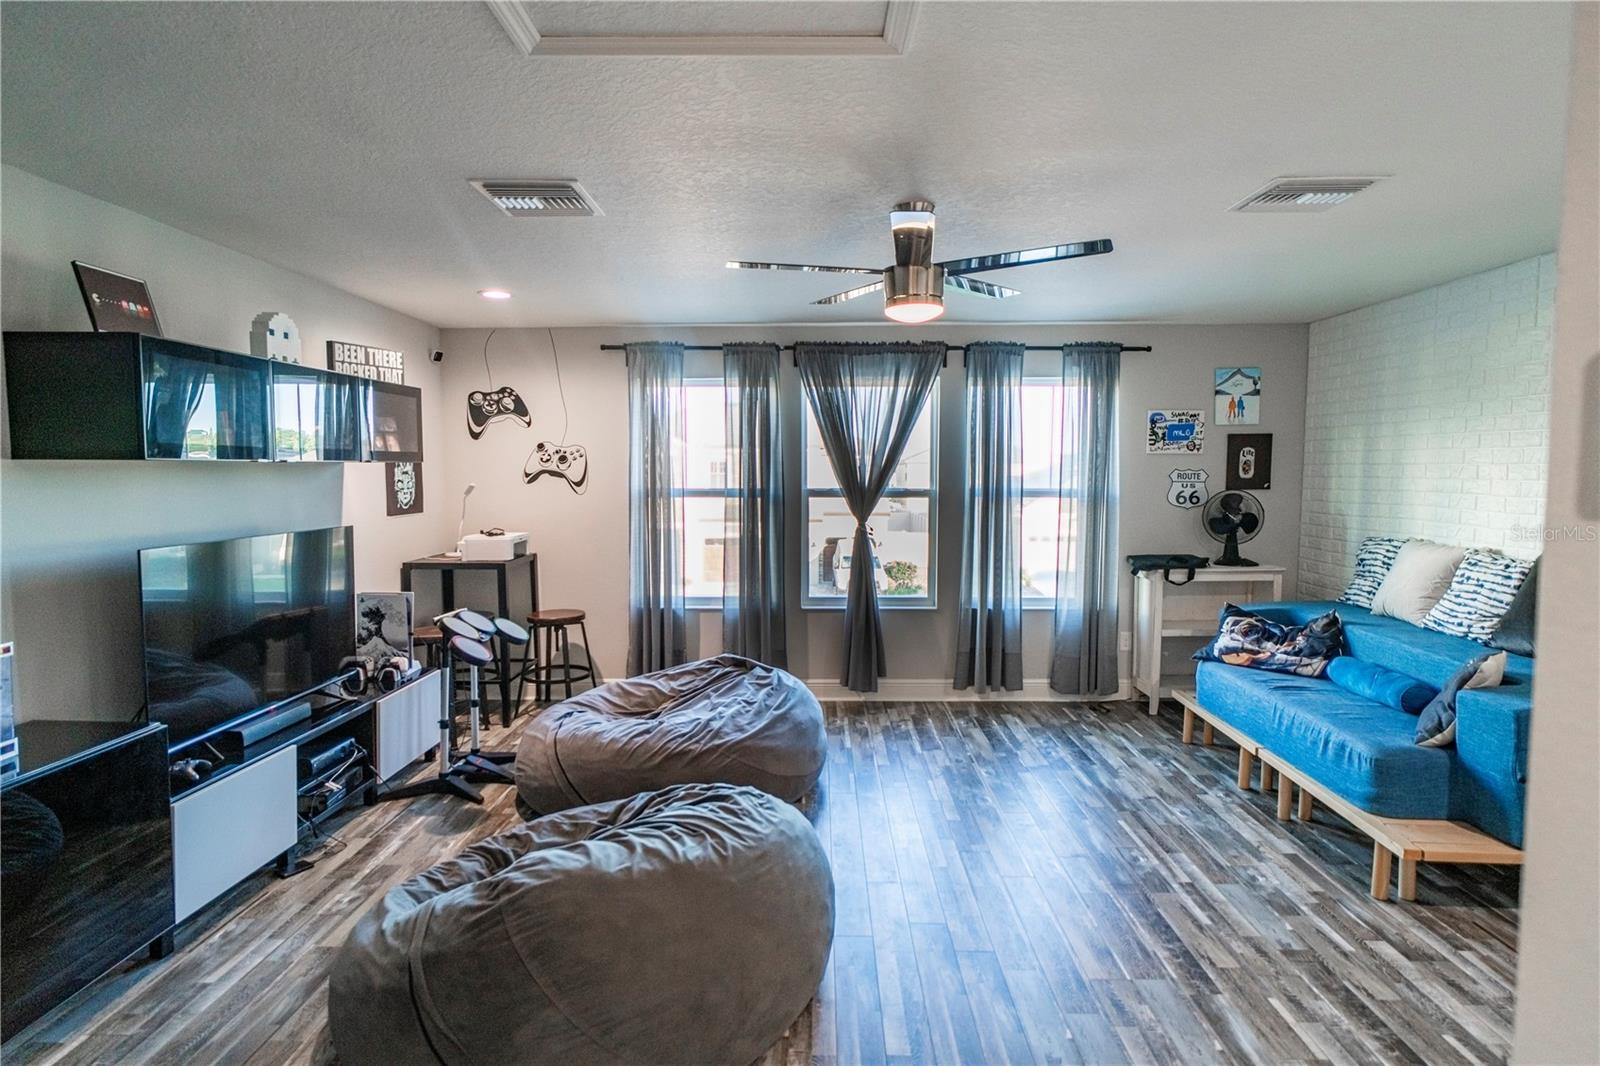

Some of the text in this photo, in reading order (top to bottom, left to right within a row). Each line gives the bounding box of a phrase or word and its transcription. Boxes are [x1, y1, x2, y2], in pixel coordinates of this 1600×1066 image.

[334, 343, 403, 368] BEEN THERE
[335, 361, 403, 385] ROCKED THAT
[1177, 472, 1201, 480] ROUTE
[1175, 490, 1201, 505] 66
